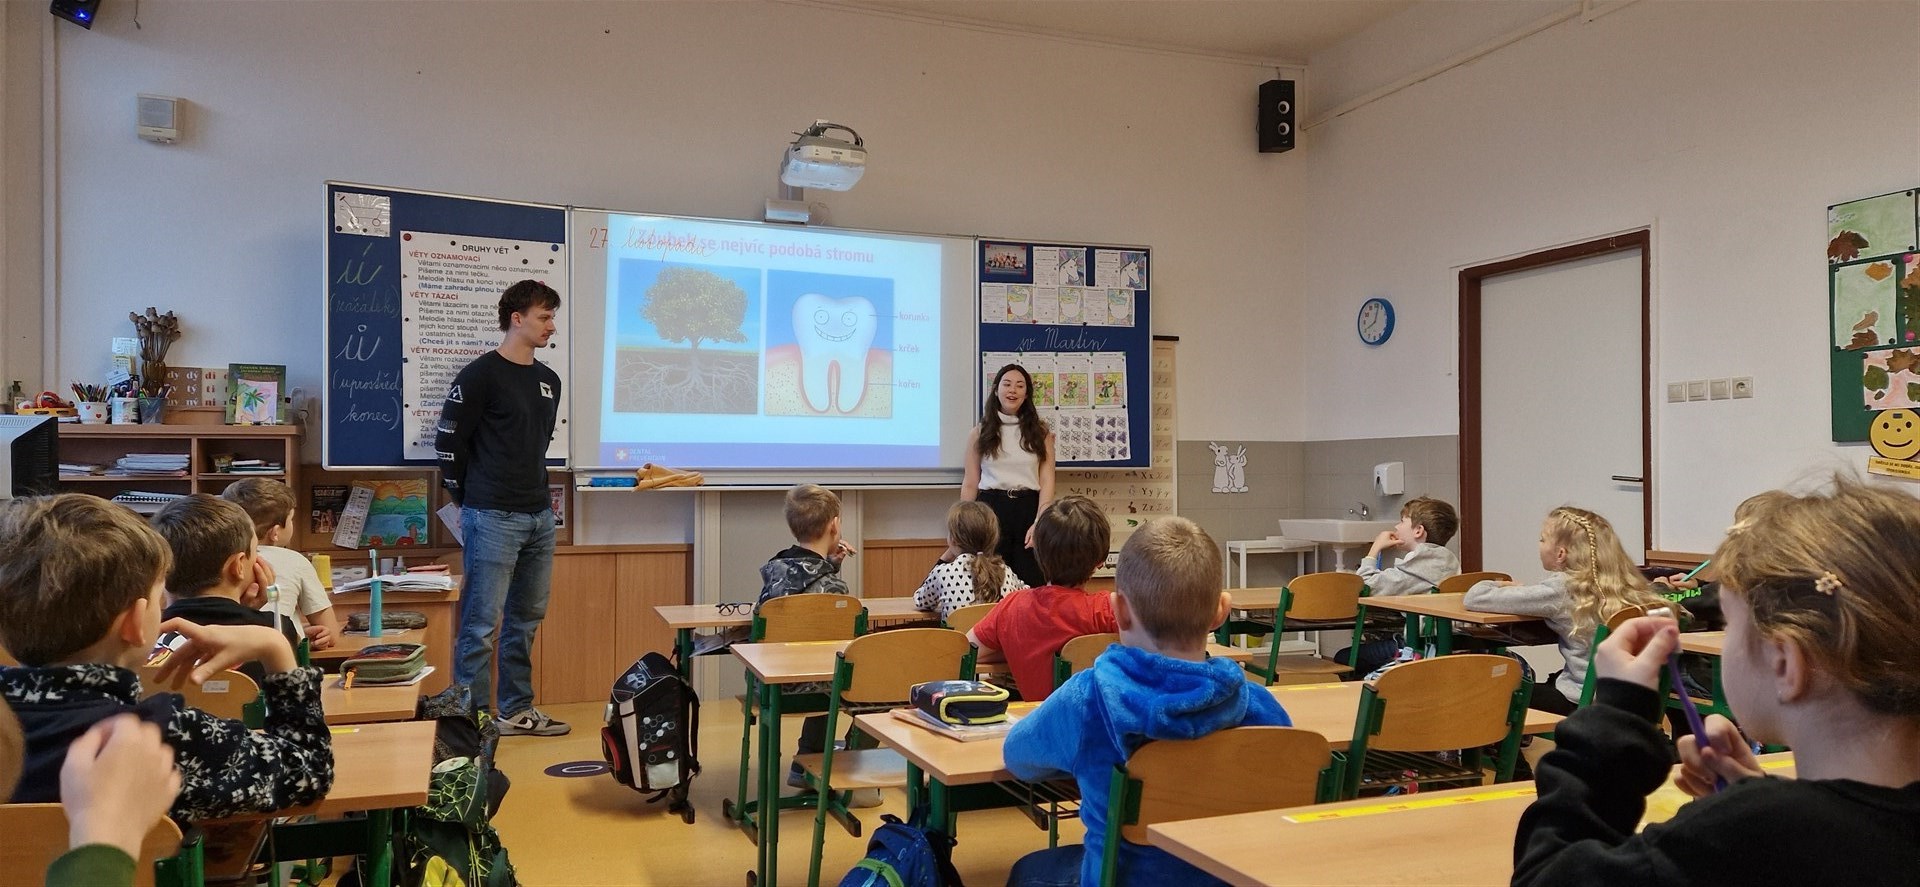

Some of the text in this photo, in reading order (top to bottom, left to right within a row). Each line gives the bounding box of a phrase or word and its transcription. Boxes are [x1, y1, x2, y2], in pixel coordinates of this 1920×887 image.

[462, 245, 509, 255] DRUHY VĚT
[700, 238, 716, 249] se
[721, 238, 764, 256] nejvíc
[769, 243, 821, 258] podobá
[826, 247, 874, 263] stromu
[409, 250, 481, 263] VĚTY OZNAMOVACÍ
[443, 262, 489, 271] oznamovacími
[491, 264, 507, 272] něco
[418, 274, 445, 282] Melodie
[446, 276, 465, 284] hlasu
[476, 277, 494, 286] konci
[495, 280, 509, 288] věty
[444, 284, 473, 292] zahradu
[474, 286, 495, 294] plnou
[432, 292, 459, 300] TÁZACÍ
[457, 324, 478, 332] stoupá
[419, 337, 445, 345] (Chceš
[462, 339, 483, 347] námi?
[1045, 327, 1108, 351] Martin
[411, 346, 486, 356] VĚTY ROZKAZOVACÍ
[899, 344, 920, 353] krček
[186, 370, 198, 381] dý
[205, 371, 216, 380] di
[899, 379, 920, 389] kořen
[187, 384, 198, 395] tý
[206, 385, 215, 393] ti
[412, 409, 431, 417] VĚTY
